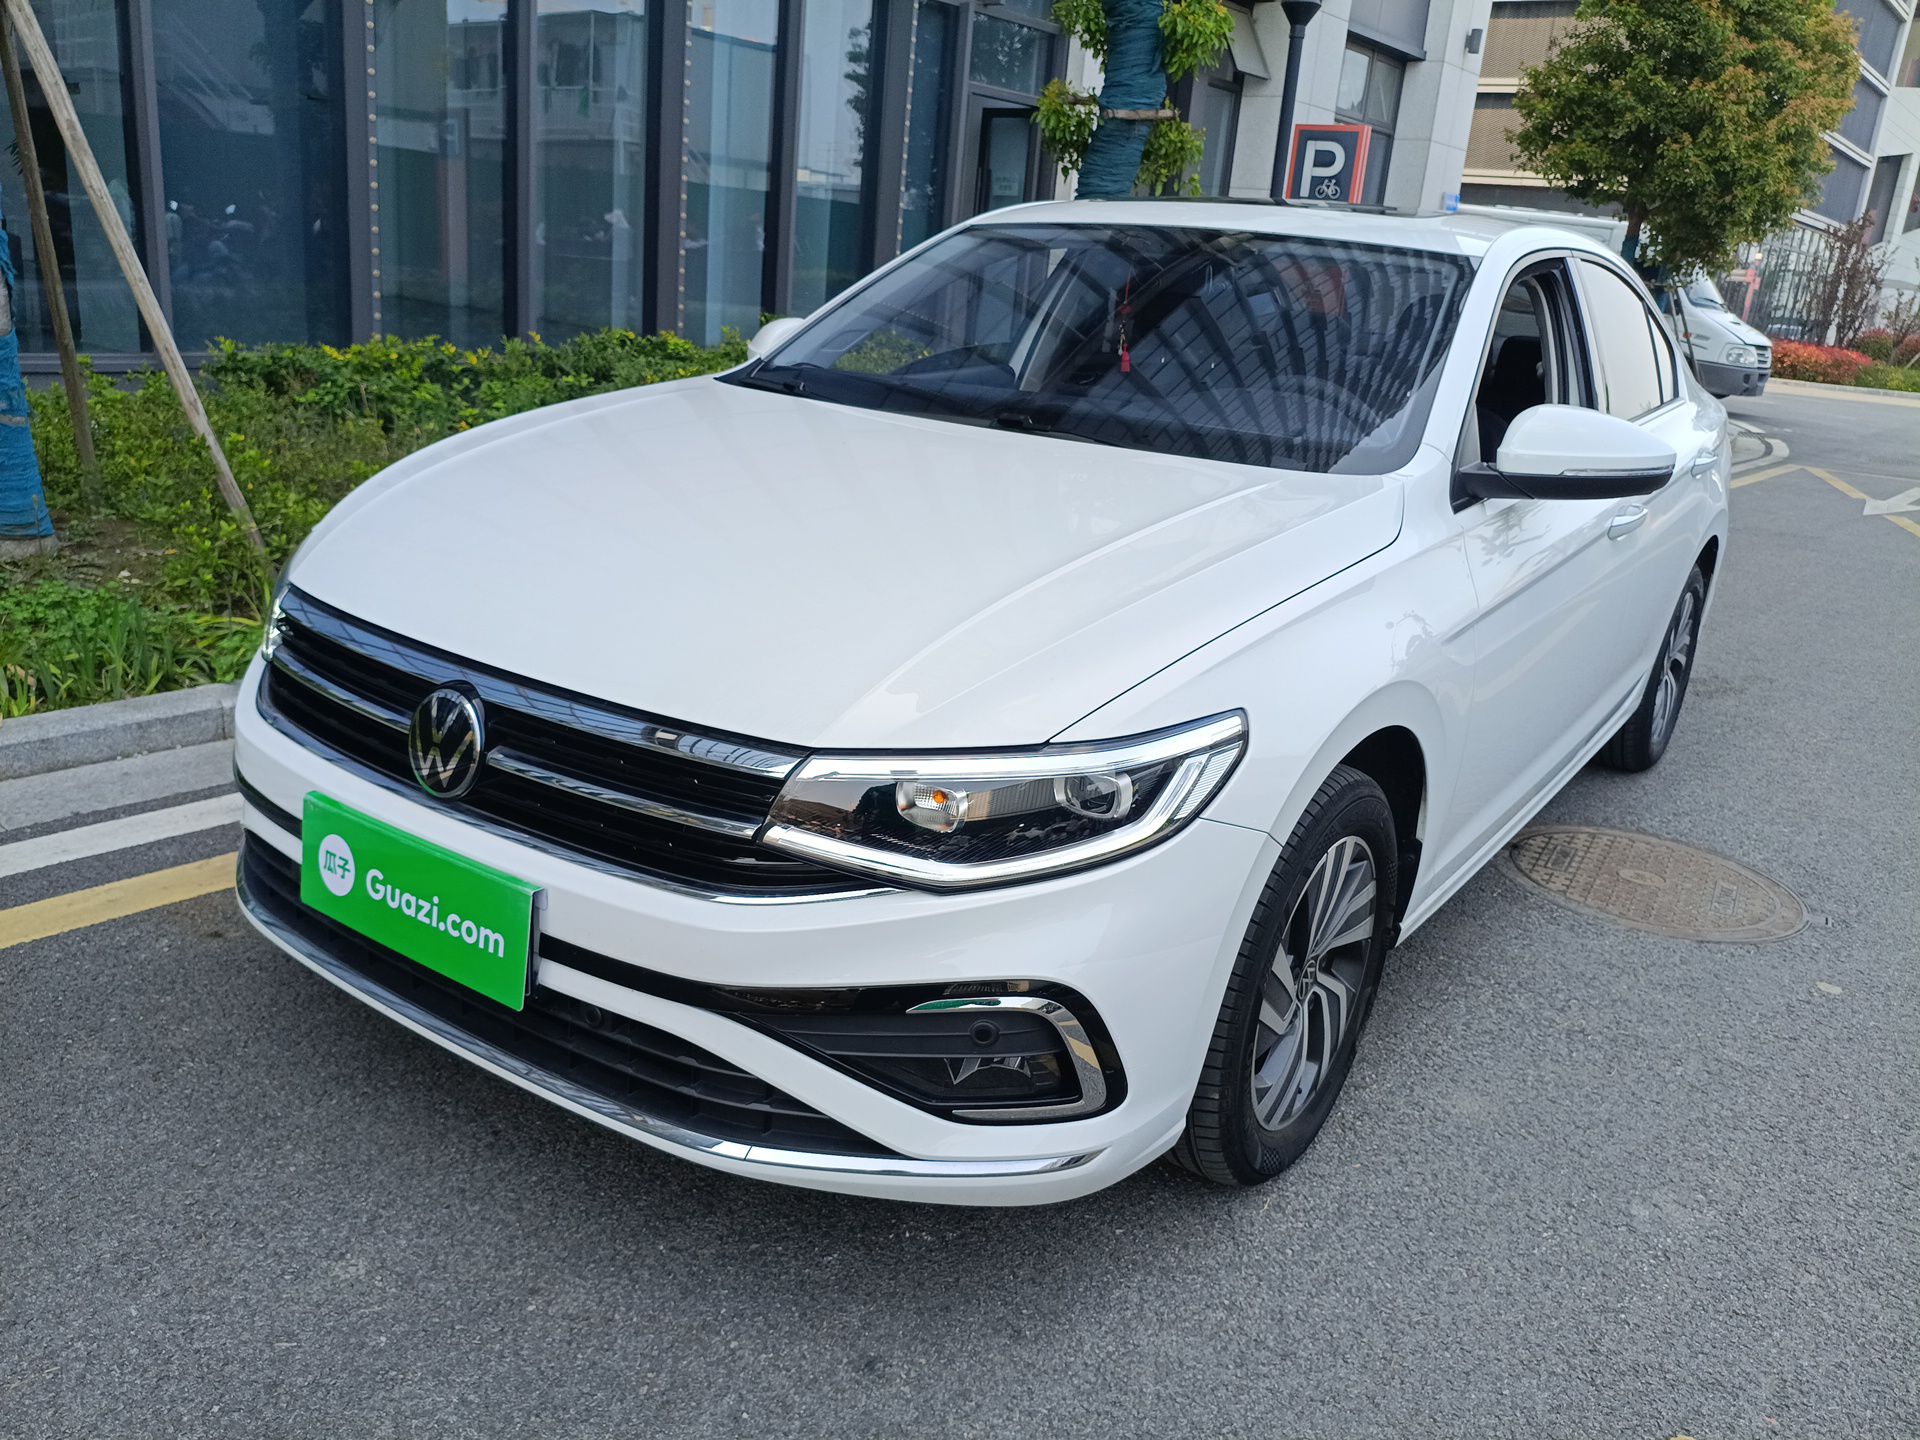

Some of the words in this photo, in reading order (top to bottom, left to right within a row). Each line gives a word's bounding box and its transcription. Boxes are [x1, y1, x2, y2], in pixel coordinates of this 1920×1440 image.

[1300, 140, 1345, 197] P
[416, 695, 474, 788] VW
[323, 850, 351, 880] 瓜子
[365, 868, 505, 958] Guazi.com
